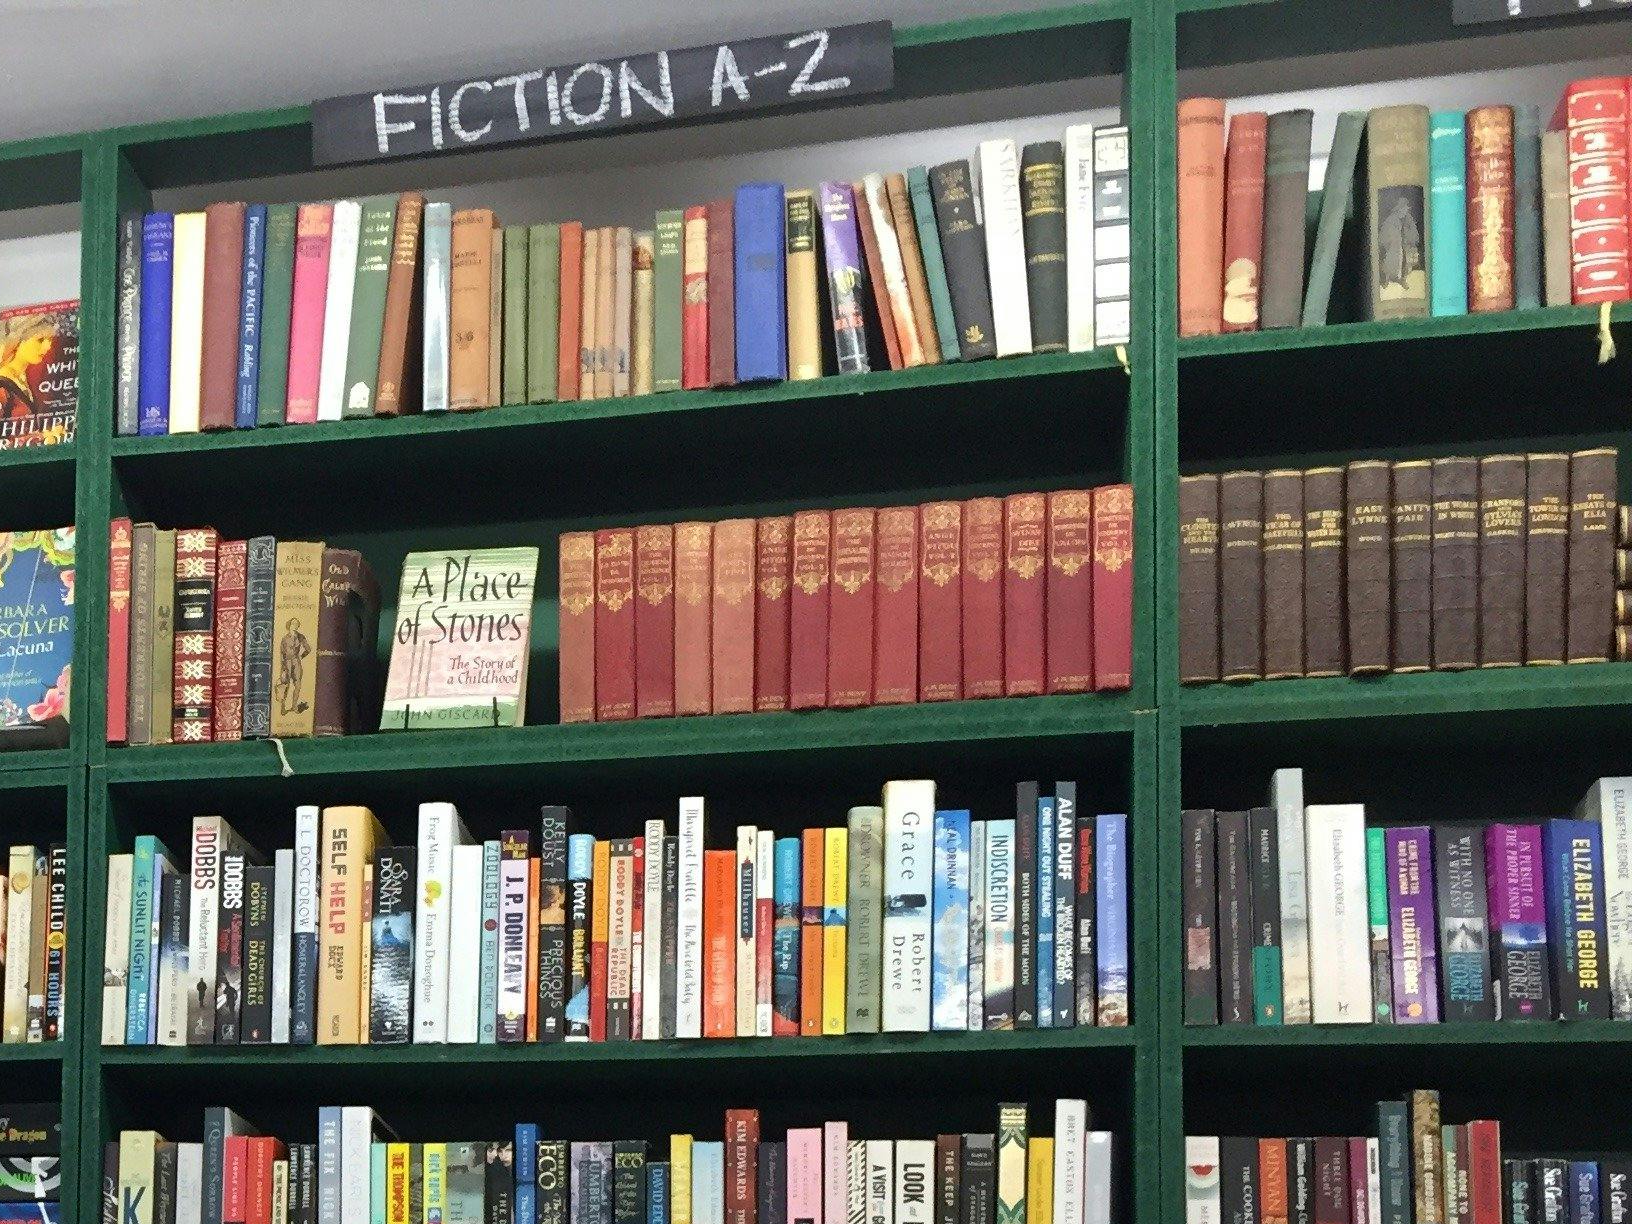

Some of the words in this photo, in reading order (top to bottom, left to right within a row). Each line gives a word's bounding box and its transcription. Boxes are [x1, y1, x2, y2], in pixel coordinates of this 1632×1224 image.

[372, 51, 674, 152] FICTION
[709, 30, 850, 106] A-Z
[413, 568, 433, 597] A
[442, 556, 528, 602] Place
[398, 602, 423, 645] of
[427, 605, 523, 645] Stones
[5, 640, 54, 658] Lacuna
[449, 656, 469, 672] The
[472, 657, 500, 672] Story
[504, 656, 517, 671] of
[447, 675, 455, 684] a
[458, 670, 519, 685] Childhood
[391, 708, 434, 723] JOHN
[1058, 798, 1074, 841] ALAN
[50, 849, 66, 875] LEE
[331, 828, 348, 875] SELF
[902, 811, 920, 881] Grace
[1058, 846, 1072, 880] DUFF
[989, 833, 1008, 925] INDISCRETION
[1572, 838, 1594, 922] ELIZABETH
[50, 880, 65, 939] CHILD
[328, 882, 345, 934] HELP
[891, 935, 906, 991] Drewe
[911, 932, 926, 994] Robert
[1577, 930, 1599, 990] GEORGE
[9, 1128, 47, 1144] Dragon
[538, 1145, 557, 1190] ECO
[903, 1162, 925, 1205] LOOK
